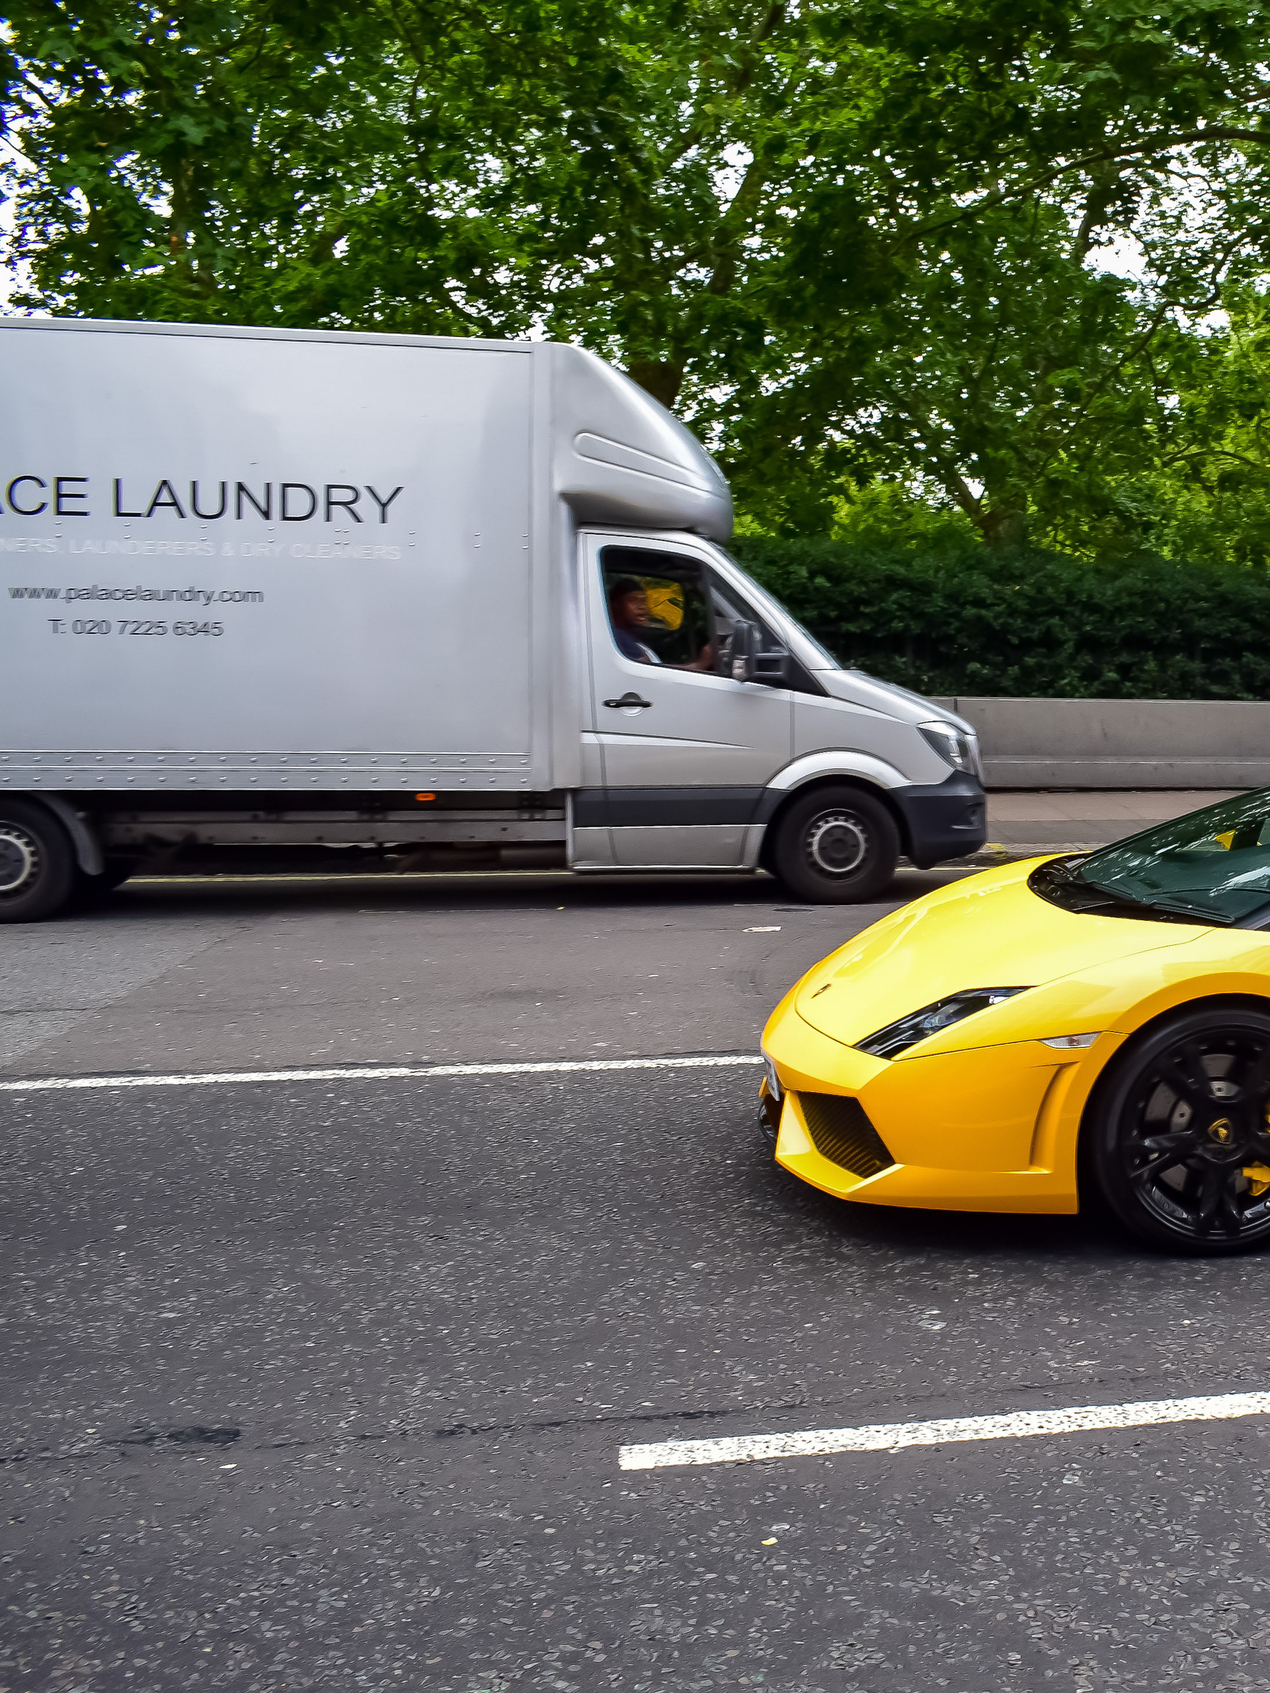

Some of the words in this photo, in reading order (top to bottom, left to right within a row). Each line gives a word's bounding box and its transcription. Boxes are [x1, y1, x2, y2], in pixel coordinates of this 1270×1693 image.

[0, 475, 90, 517] CE
[113, 477, 405, 524] LAUNDRY
[69, 538, 216, 557] LAUNDERERS
[221, 541, 235, 557] &
[240, 542, 287, 558] DRY
[289, 543, 403, 560] CLEANERS
[8, 584, 264, 606] www.palacelaundry.com
[71, 619, 112, 635] 020
[115, 620, 168, 636] 7225
[172, 621, 224, 637] 6345
